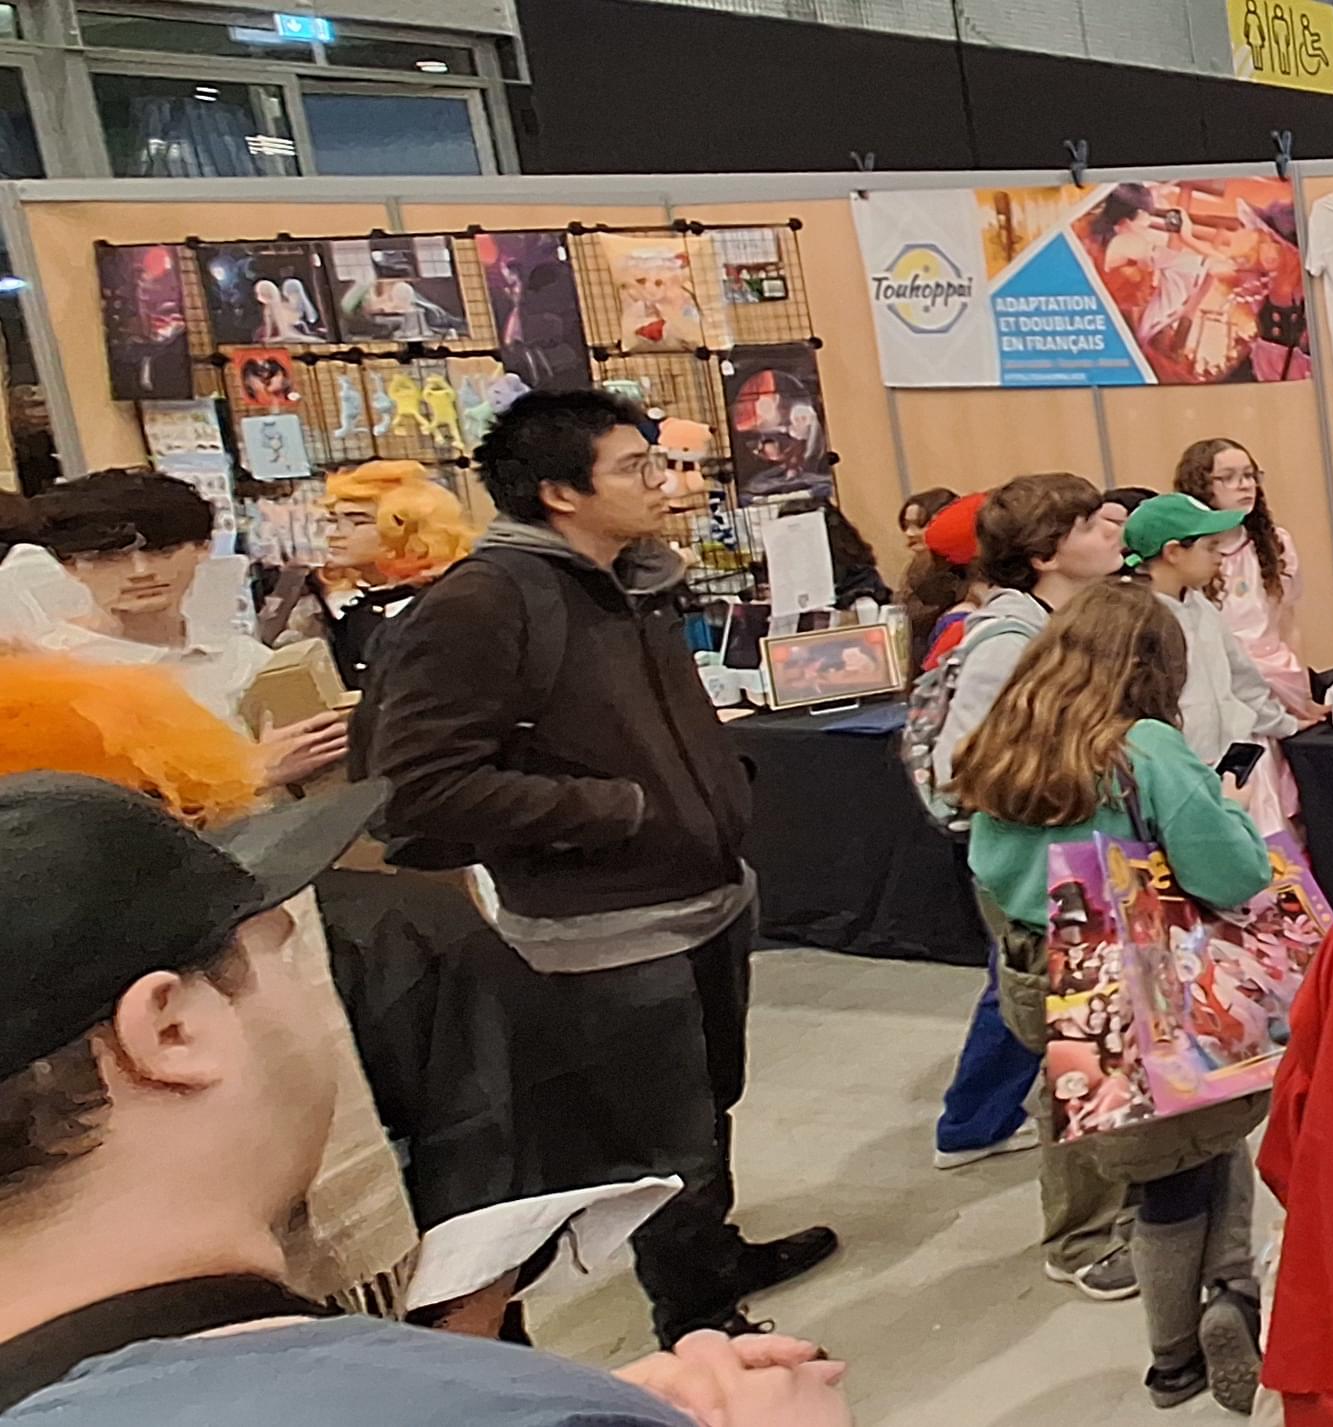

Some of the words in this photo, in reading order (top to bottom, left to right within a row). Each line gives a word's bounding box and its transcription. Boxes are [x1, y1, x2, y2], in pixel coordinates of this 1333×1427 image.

[871, 273, 973, 308] Touhoppai
[996, 295, 1098, 312] ADAPTATION
[999, 316, 1016, 332] ET
[1019, 314, 1106, 332] DOUBLAGE
[1002, 335, 1024, 352] EN
[1025, 334, 1106, 355] FRANÇAIS
